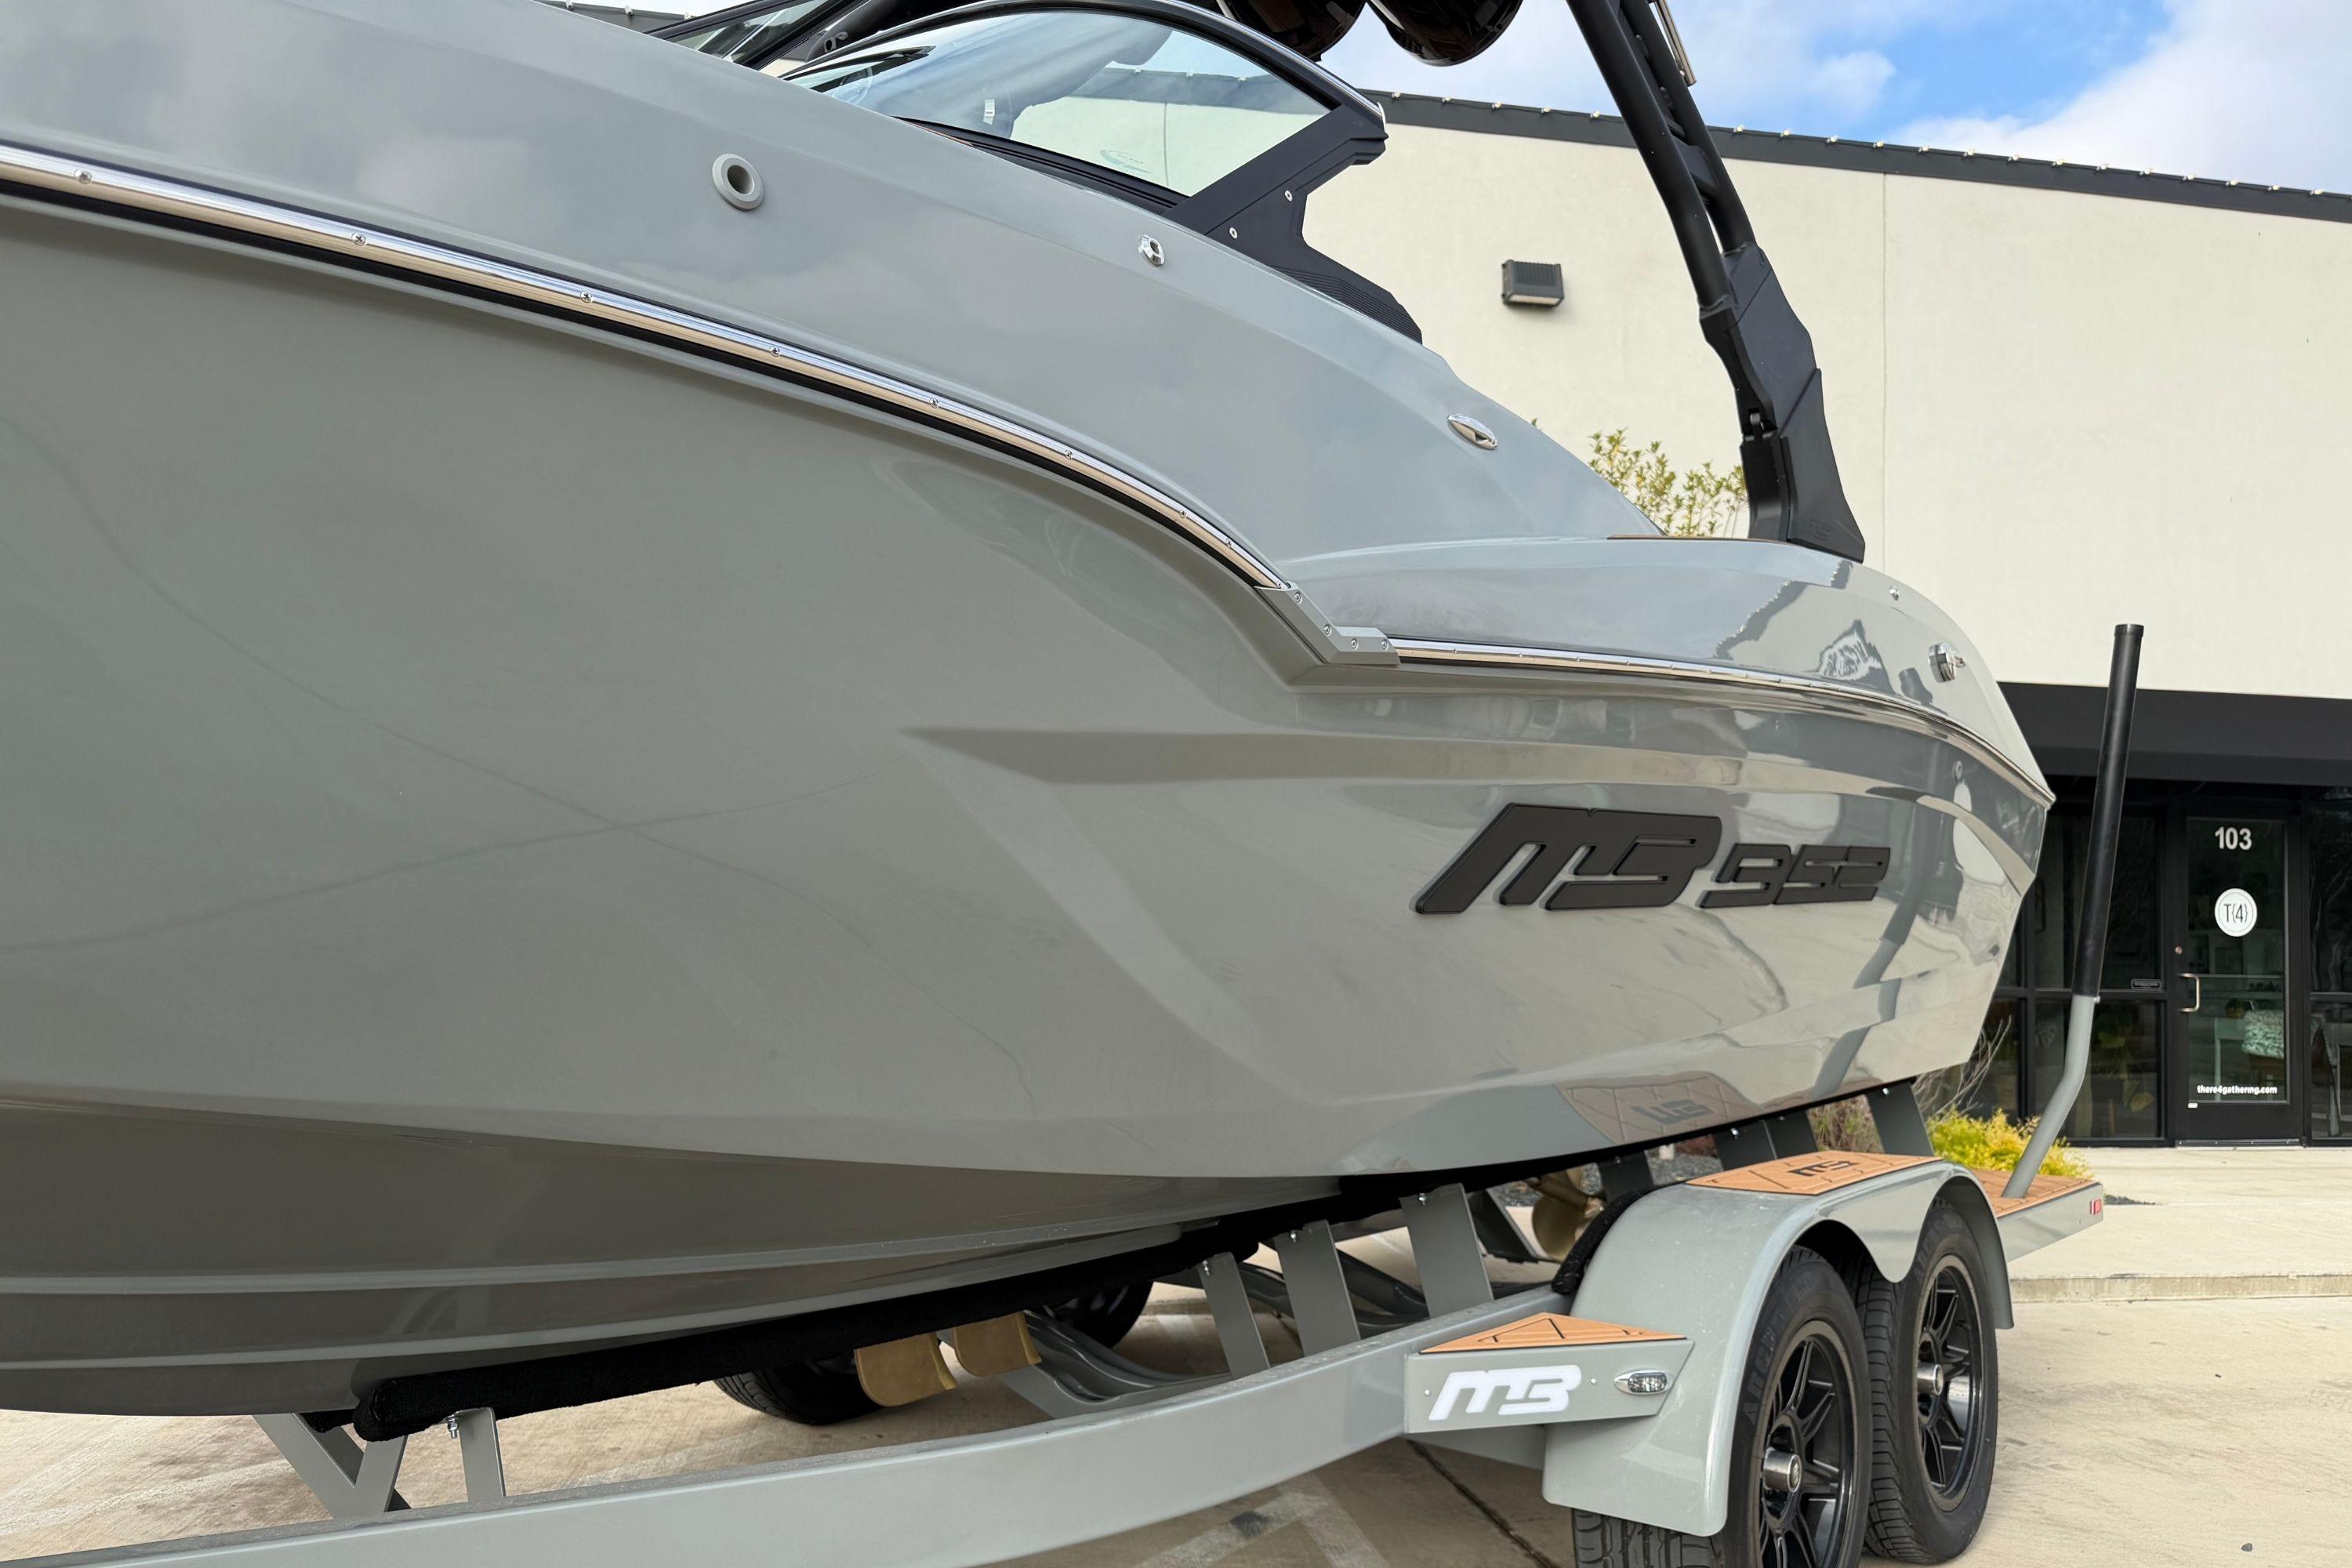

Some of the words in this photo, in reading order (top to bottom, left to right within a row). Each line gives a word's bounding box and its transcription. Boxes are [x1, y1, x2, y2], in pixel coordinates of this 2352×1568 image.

[1415, 802, 1722, 915] MB
[2214, 826, 2252, 851] 103
[2196, 1083, 2278, 1096] there4gathering.com
[1428, 1363, 1583, 1421] MB
